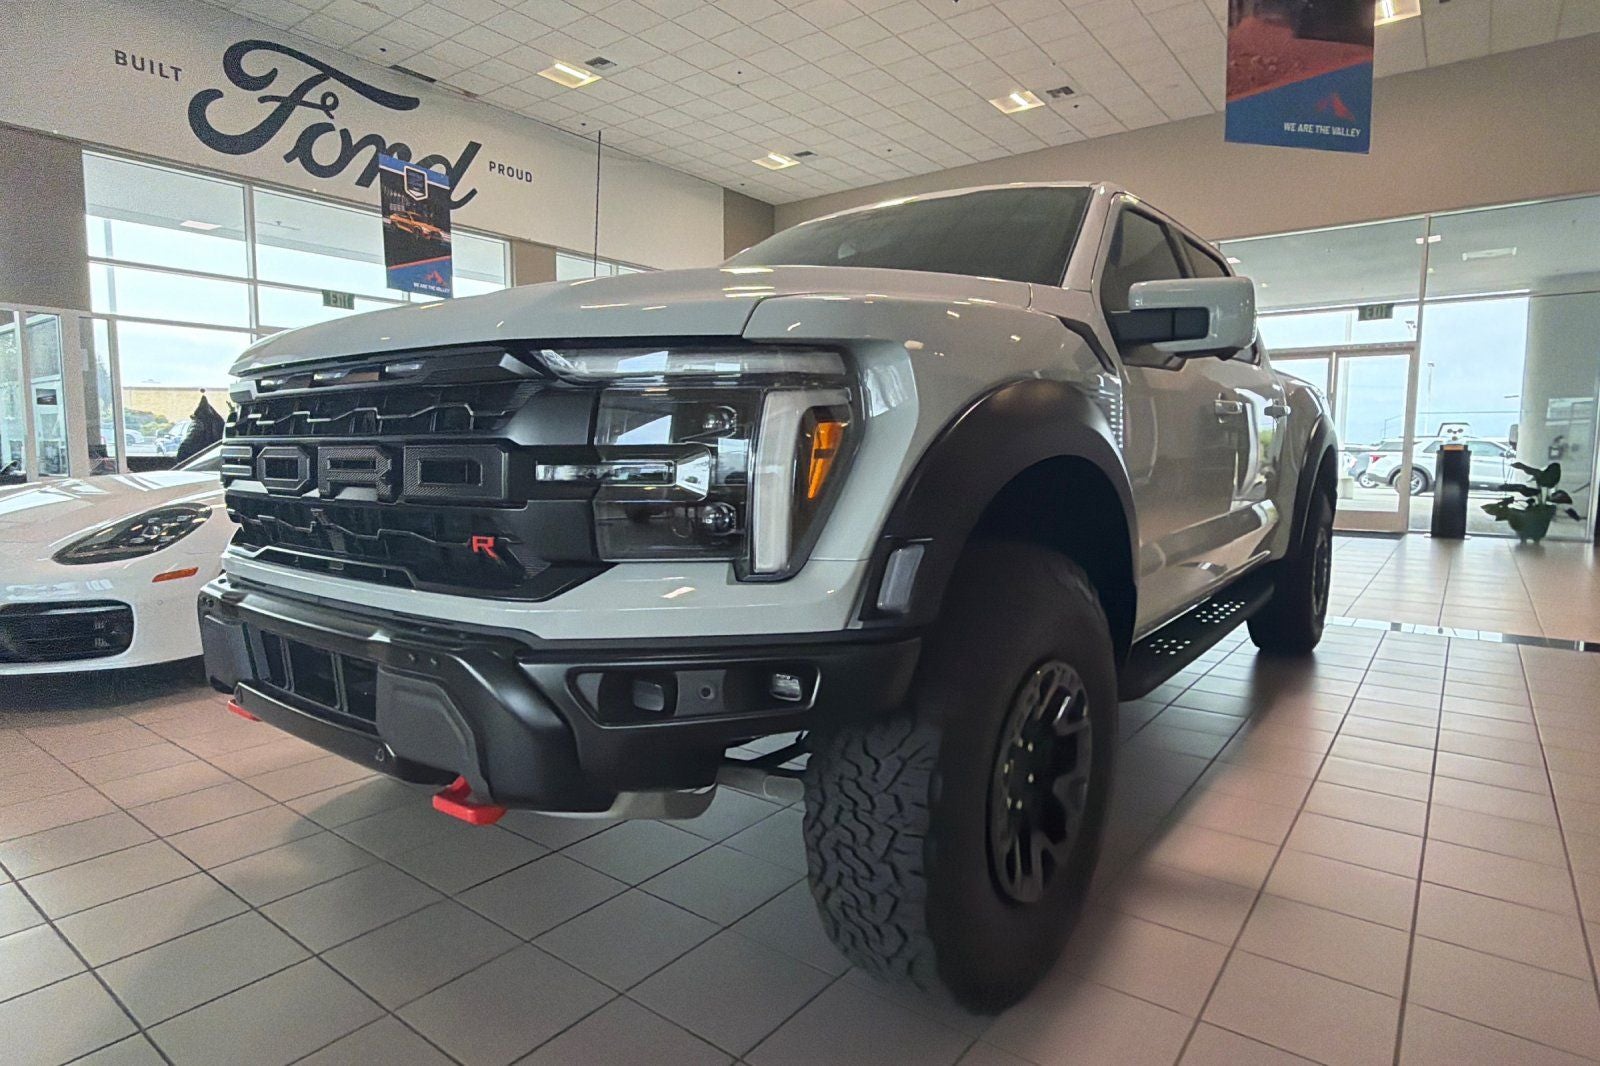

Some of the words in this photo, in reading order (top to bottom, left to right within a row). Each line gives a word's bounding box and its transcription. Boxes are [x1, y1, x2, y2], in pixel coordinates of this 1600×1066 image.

[114, 49, 182, 82] BUILT
[489, 160, 533, 183] PROUD
[1283, 122, 1297, 132] WE
[1297, 123, 1314, 134] ARE
[1315, 125, 1331, 134] THE
[1332, 126, 1361, 137] VALLEY
[472, 535, 499, 560] R
